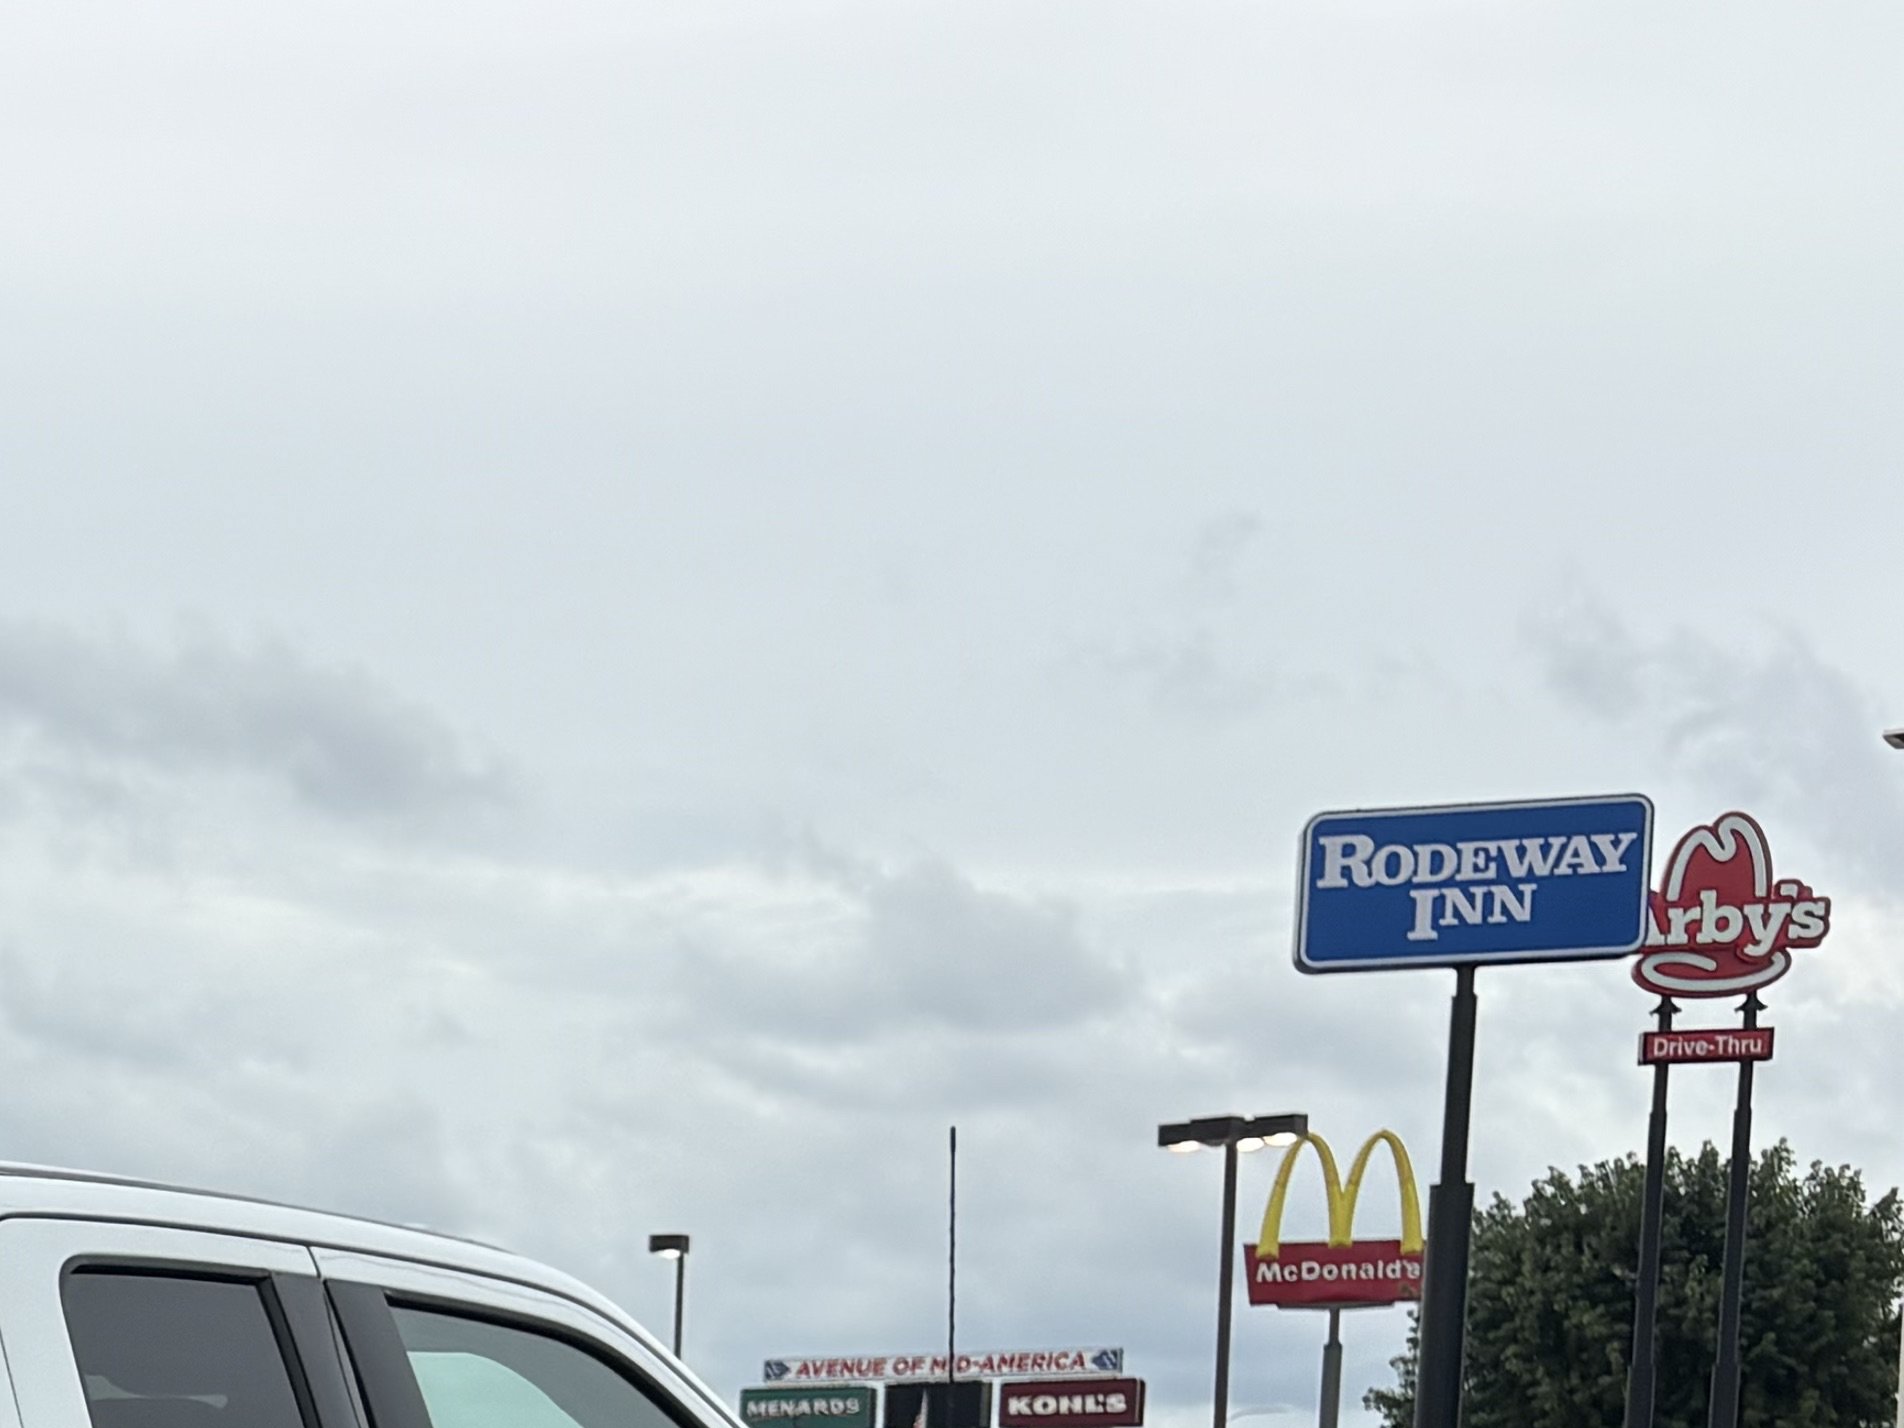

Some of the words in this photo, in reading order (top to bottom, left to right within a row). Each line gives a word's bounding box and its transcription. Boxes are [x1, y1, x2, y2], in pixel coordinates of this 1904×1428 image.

[1316, 831, 1638, 890] RODEWAY
[1406, 883, 1538, 942] INN
[1652, 1033, 1764, 1058] Drive-Thru
[1255, 1258, 1422, 1284] McDonald's
[795, 1355, 886, 1378] AVENUE
[893, 1354, 927, 1376] OF
[746, 1396, 861, 1418] MENARDS
[1007, 1392, 1128, 1416] KOHL'S
